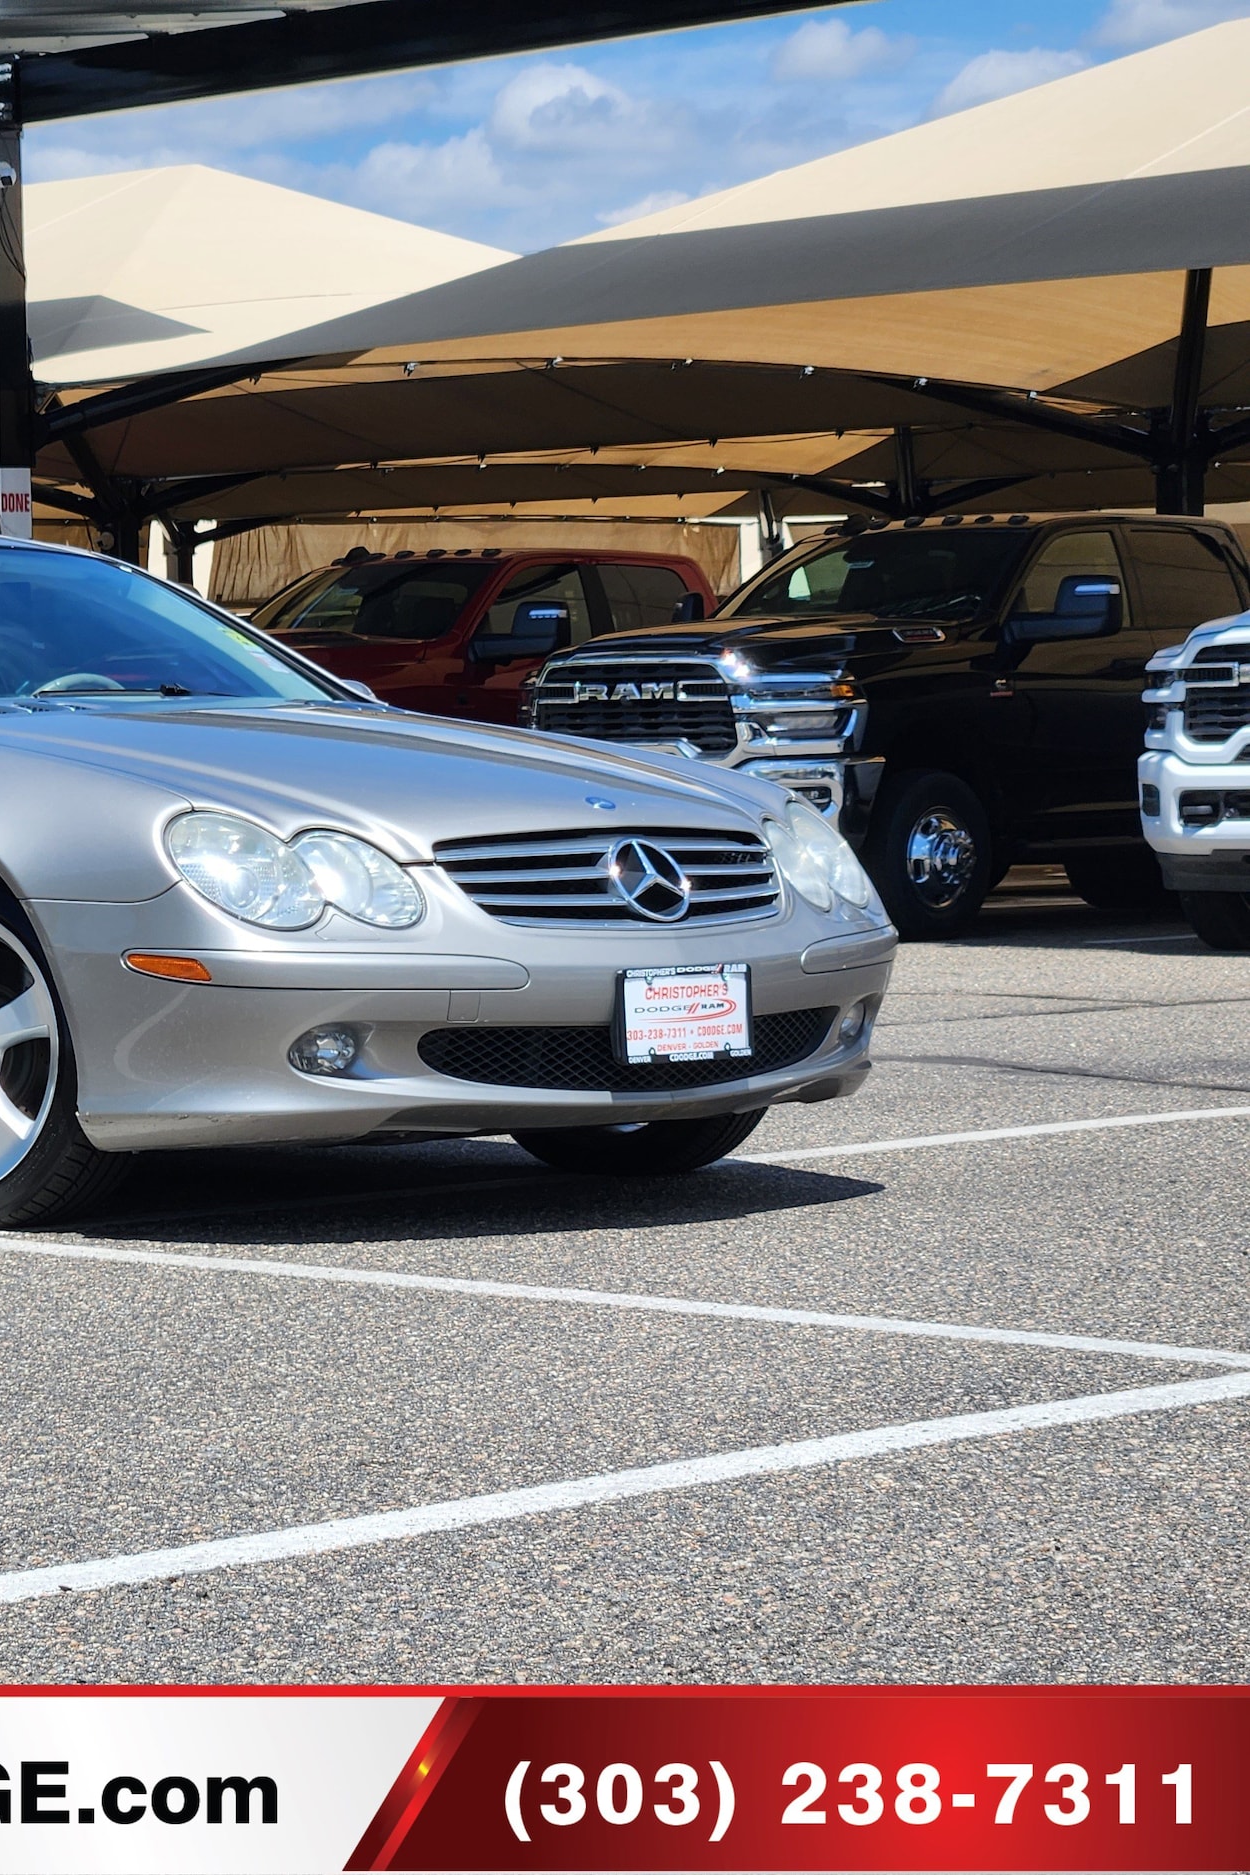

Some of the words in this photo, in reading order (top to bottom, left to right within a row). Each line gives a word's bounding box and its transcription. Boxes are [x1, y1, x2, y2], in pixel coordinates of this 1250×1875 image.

[1, 493, 30, 512] DONE
[578, 682, 674, 700] RAM
[645, 983, 729, 1000] CHRISTOPHER'S
[634, 1004, 690, 1014] DODGE
[701, 1002, 725, 1010] RAM
[627, 1027, 687, 1041] 303-238-7311
[697, 1024, 743, 1037] CDODGE.COM
[657, 1043, 687, 1052] DENVER
[693, 1041, 719, 1050] GOLDEN
